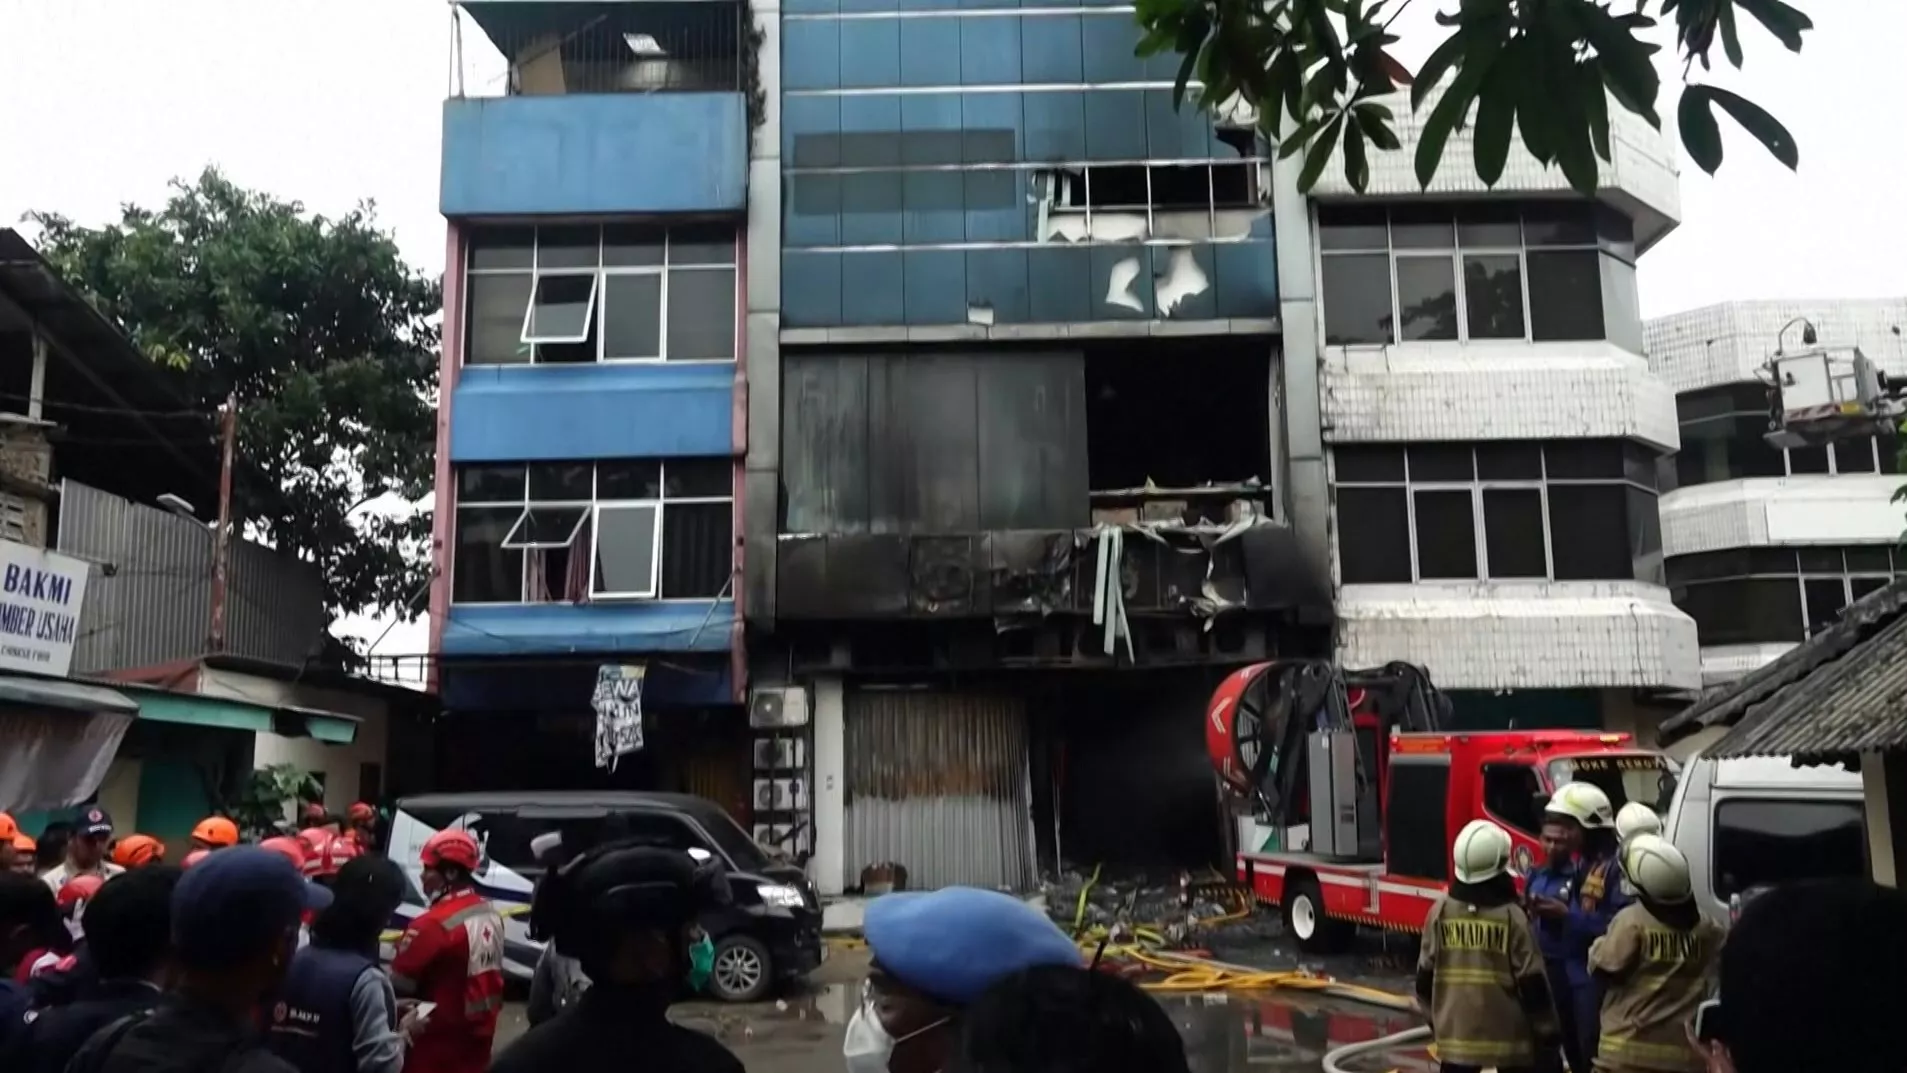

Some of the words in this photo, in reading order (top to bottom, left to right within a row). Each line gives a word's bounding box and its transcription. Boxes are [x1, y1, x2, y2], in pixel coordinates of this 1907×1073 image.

[4, 563, 72, 605] BAKMI
[36, 609, 75, 646] USAHA
[1441, 922, 1505, 951] PEMADAM
